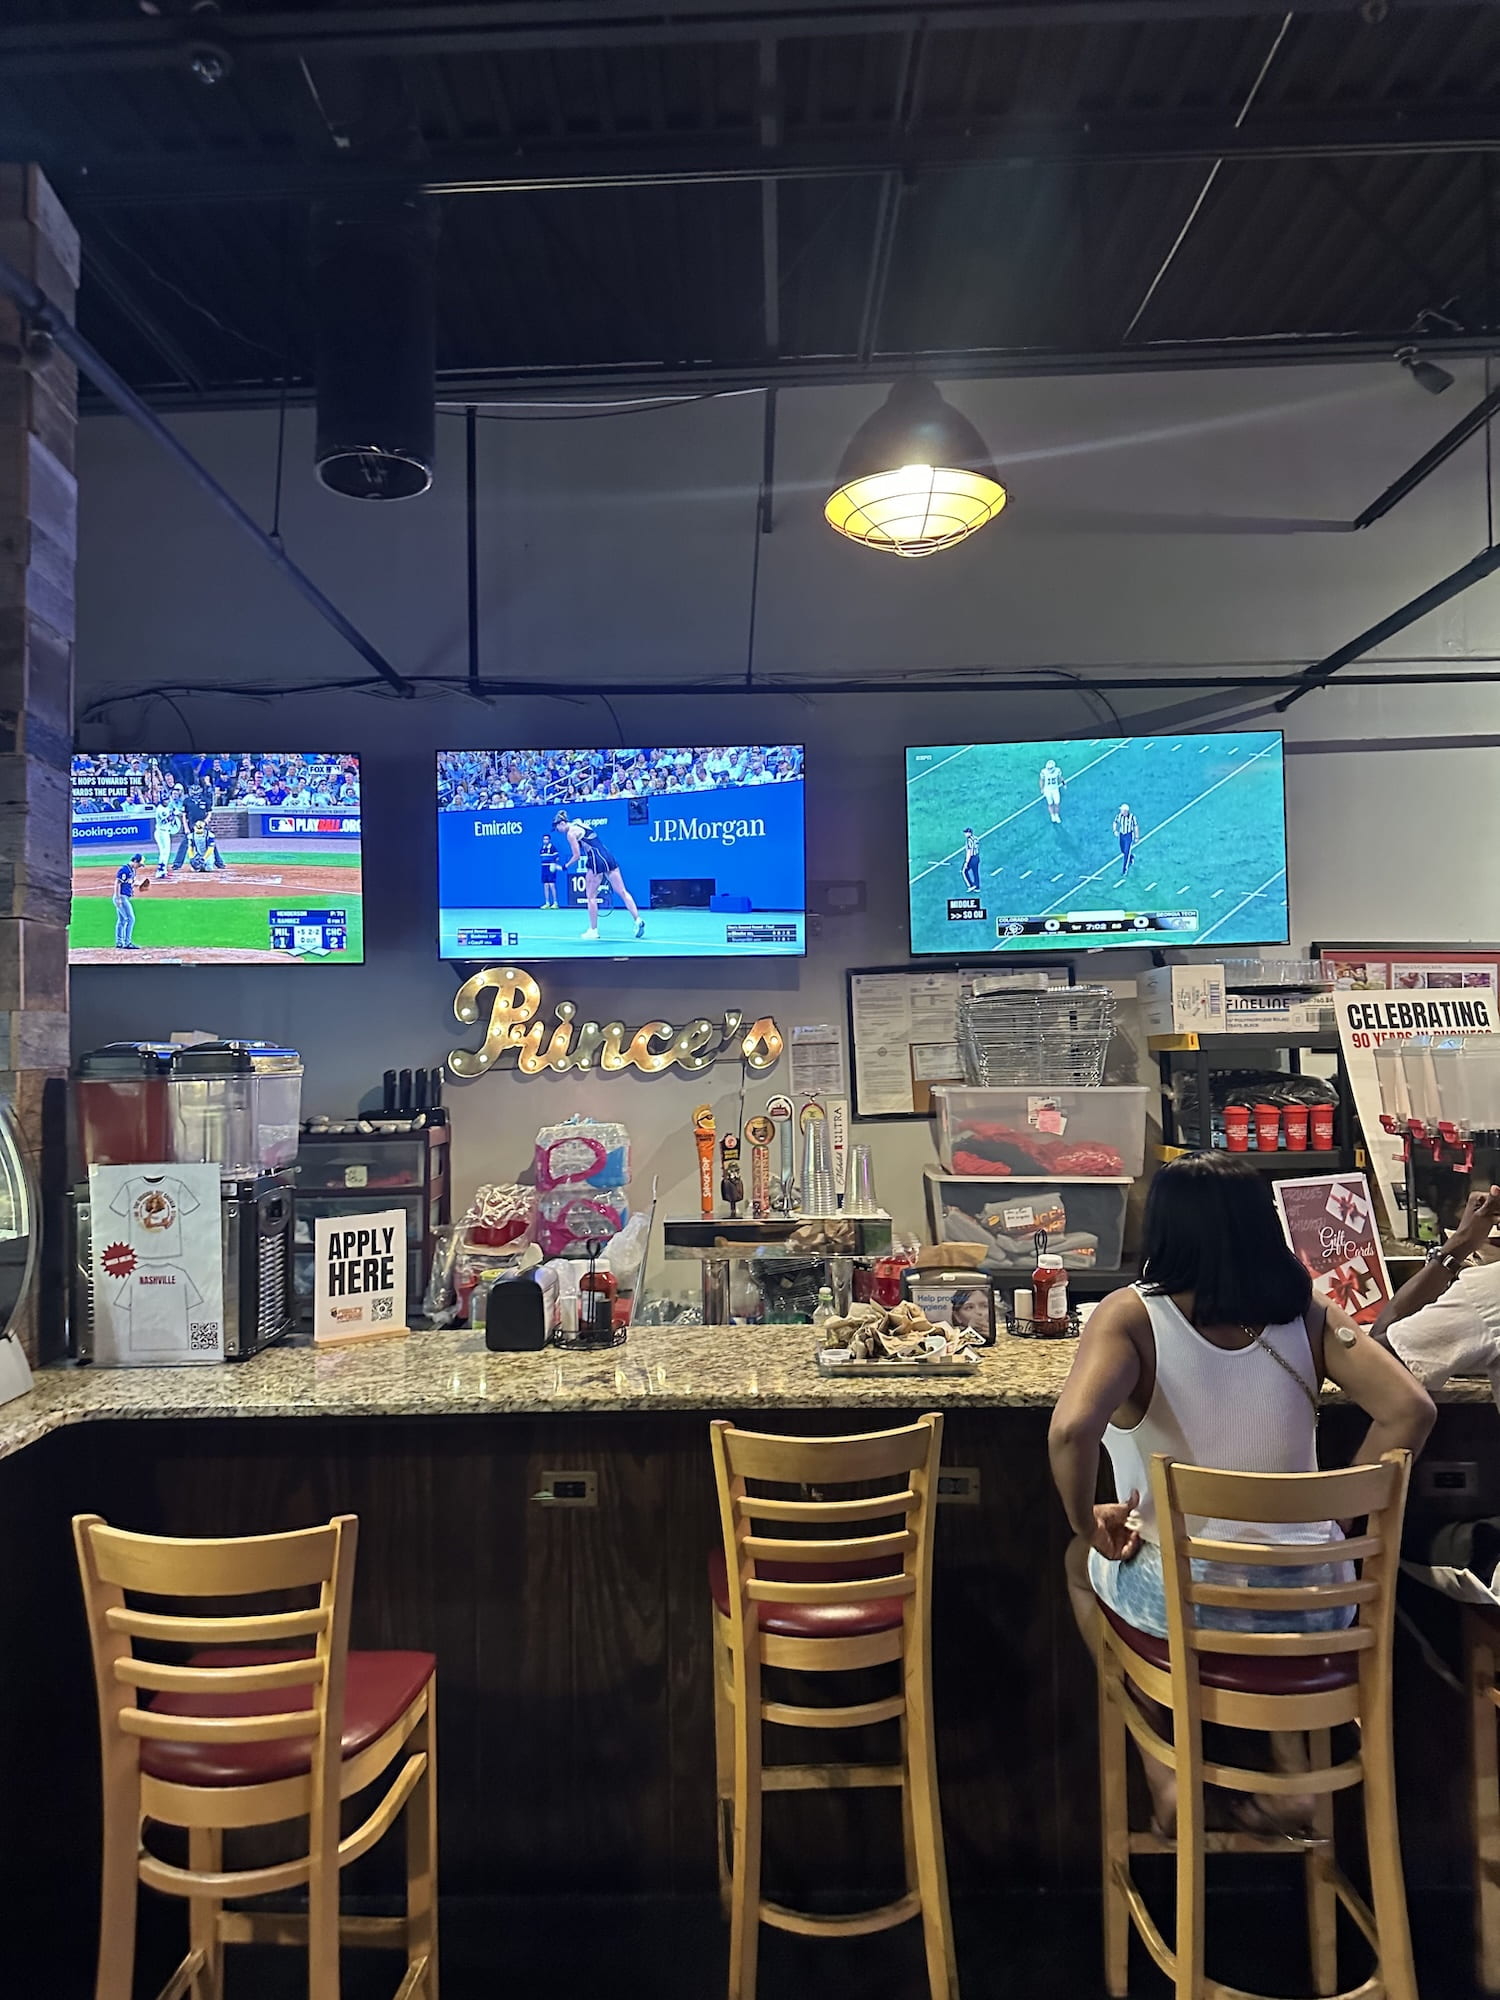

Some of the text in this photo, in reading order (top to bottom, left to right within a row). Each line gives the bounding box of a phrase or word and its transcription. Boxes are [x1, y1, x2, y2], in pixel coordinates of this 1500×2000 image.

[79, 776, 96, 785] HOPS
[97, 776, 129, 785] TOWARDS
[129, 776, 143, 785] THE
[94, 788, 107, 796] THE
[108, 787, 128, 796] PLATE
[474, 820, 523, 836] Emirates
[592, 818, 608, 827] open
[72, 826, 138, 837] Booking.com
[649, 817, 766, 847] J.P.Morgan
[275, 928, 290, 936] MIL
[330, 937, 339, 949] 2
[1226, 998, 1290, 1010] FINELINE
[448, 966, 784, 1078] Prince's
[1347, 1001, 1490, 1030] CELEBRATING
[1352, 1032, 1371, 1048] 90
[834, 1107, 843, 1142] ULTRA
[702, 1157, 711, 1171] TOP
[702, 1173, 711, 1198] SHOCK
[328, 1227, 395, 1260] APPLY
[1319, 1226, 1345, 1258] Gift
[1343, 1240, 1375, 1260] Cards
[139, 1275, 176, 1285] NASHVILLE
[328, 1256, 394, 1297] HERE
[917, 1294, 936, 1303] Help
[921, 1303, 948, 1312] ygiene
